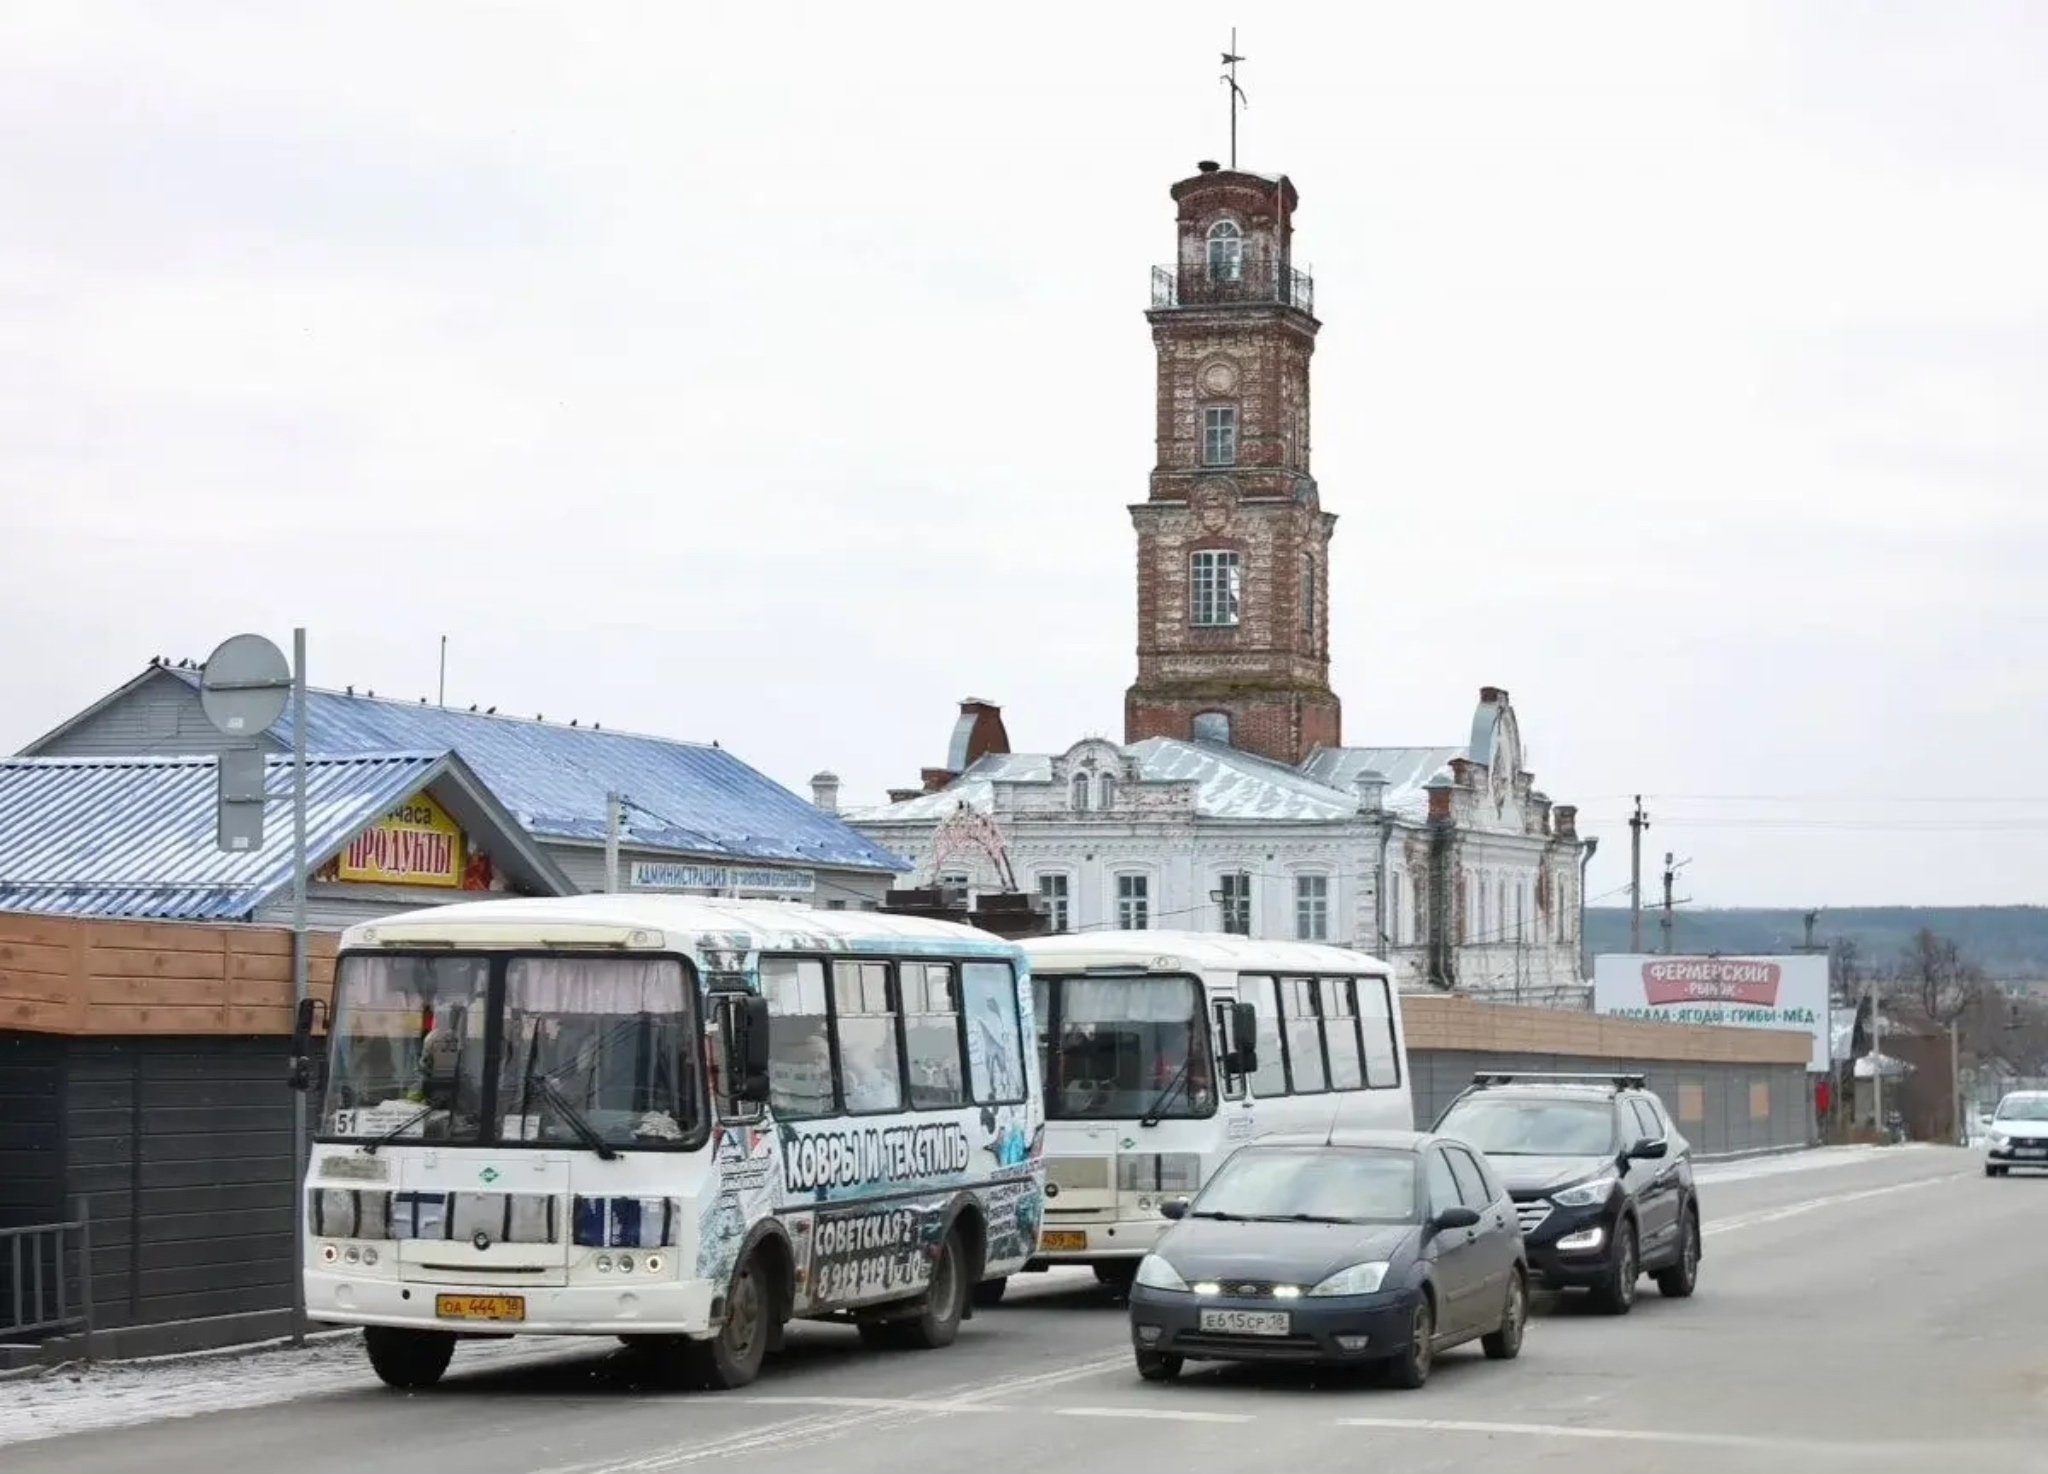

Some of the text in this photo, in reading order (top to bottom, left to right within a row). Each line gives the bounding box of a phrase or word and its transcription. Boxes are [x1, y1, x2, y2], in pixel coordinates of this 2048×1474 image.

[348, 826, 454, 876] ПРОДУКТЫ
[337, 1113, 357, 1134] 51
[787, 1121, 970, 1193] КОВРЫ И ТЕКСТИЛЬ
[815, 1212, 901, 1257] СОВЕТСКАЯ
[469, 1299, 496, 1314] 444
